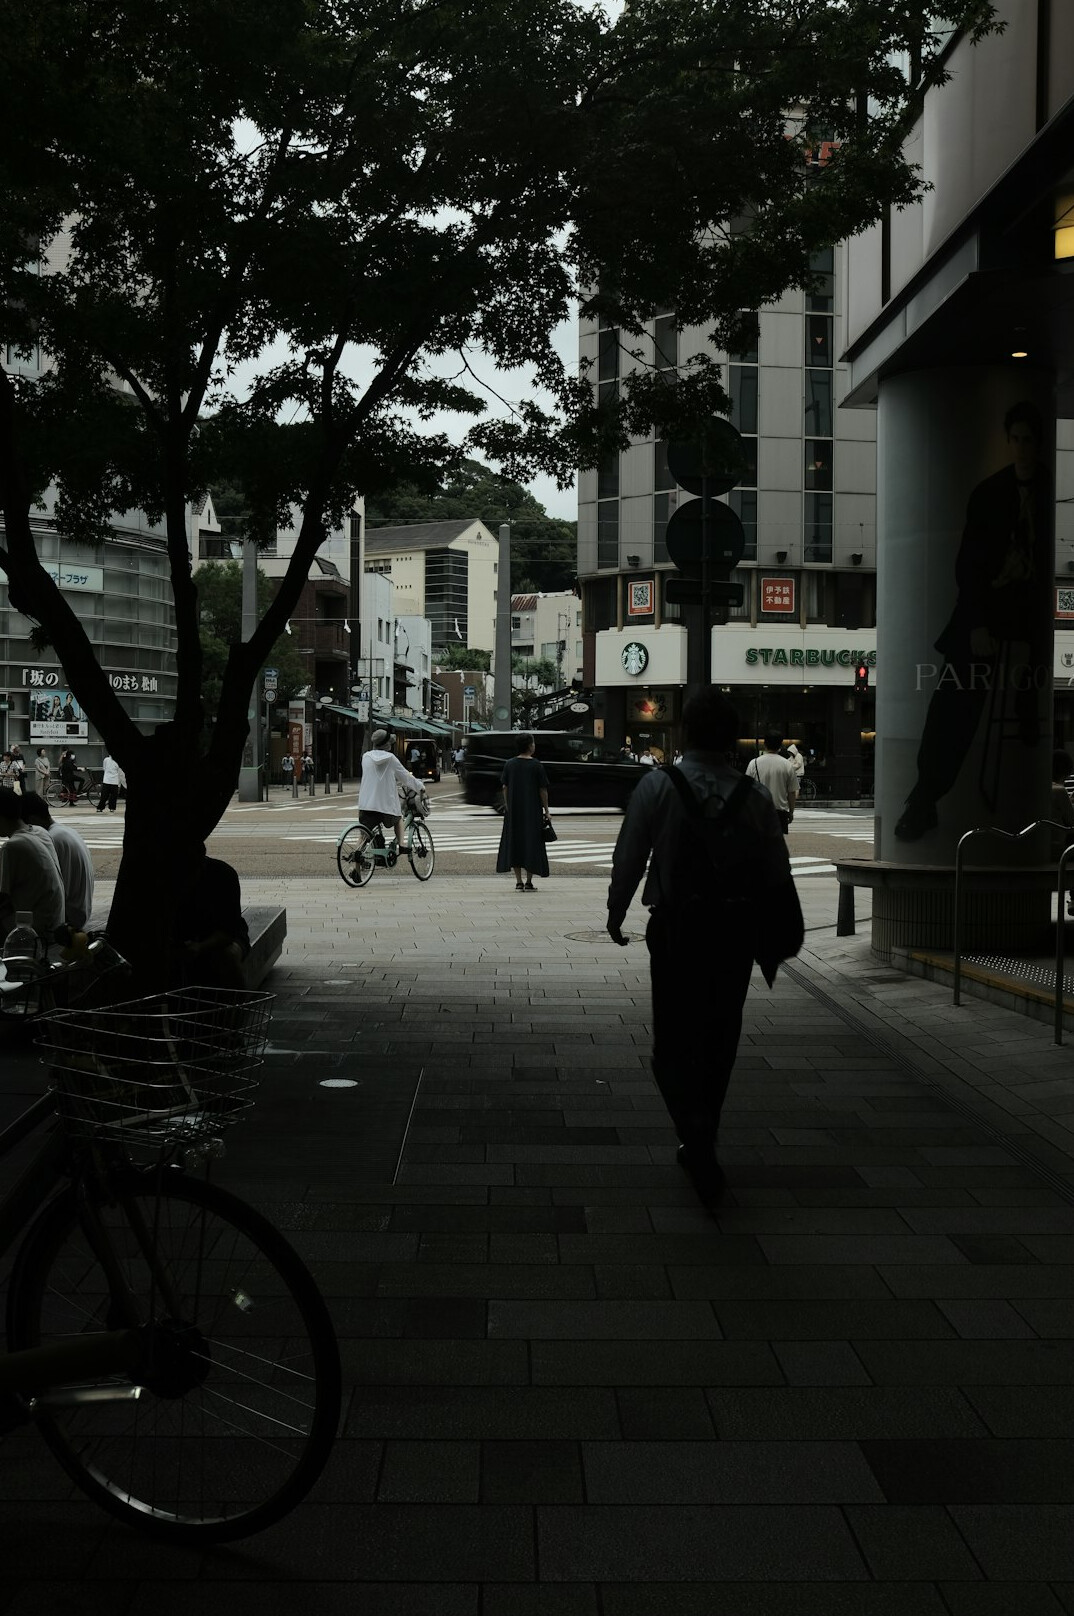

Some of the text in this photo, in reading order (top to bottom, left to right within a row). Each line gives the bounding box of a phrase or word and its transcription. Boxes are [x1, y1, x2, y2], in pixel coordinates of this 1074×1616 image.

[48, 571, 88, 585] ネープラザ
[765, 596, 790, 605] 不動産
[745, 648, 877, 667] STARBUCKS
[141, 676, 158, 692] 松山
